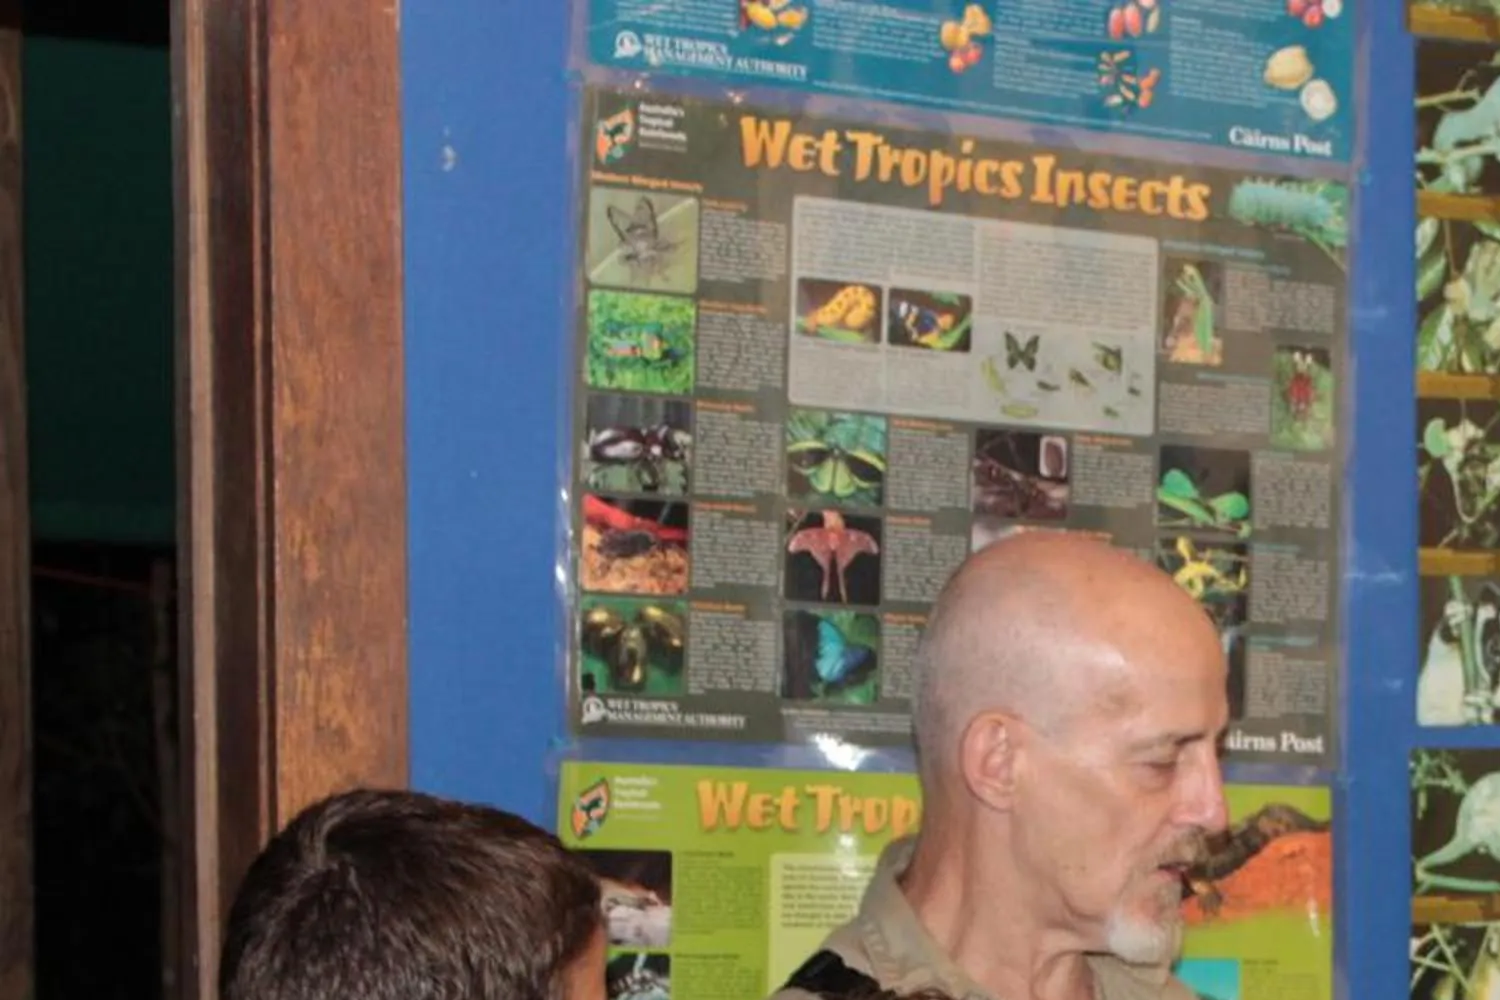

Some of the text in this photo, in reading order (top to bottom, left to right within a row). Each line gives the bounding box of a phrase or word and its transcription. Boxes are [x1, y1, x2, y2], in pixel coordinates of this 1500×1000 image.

[735, 58, 808, 81] AUTHORITY
[1229, 125, 1332, 157] Cairns Post
[739, 115, 1212, 222] Wet Tropics Insects
[685, 714, 746, 728] AUTHORITY
[1225, 729, 1324, 755] airns Post
[697, 778, 800, 834] Wet
